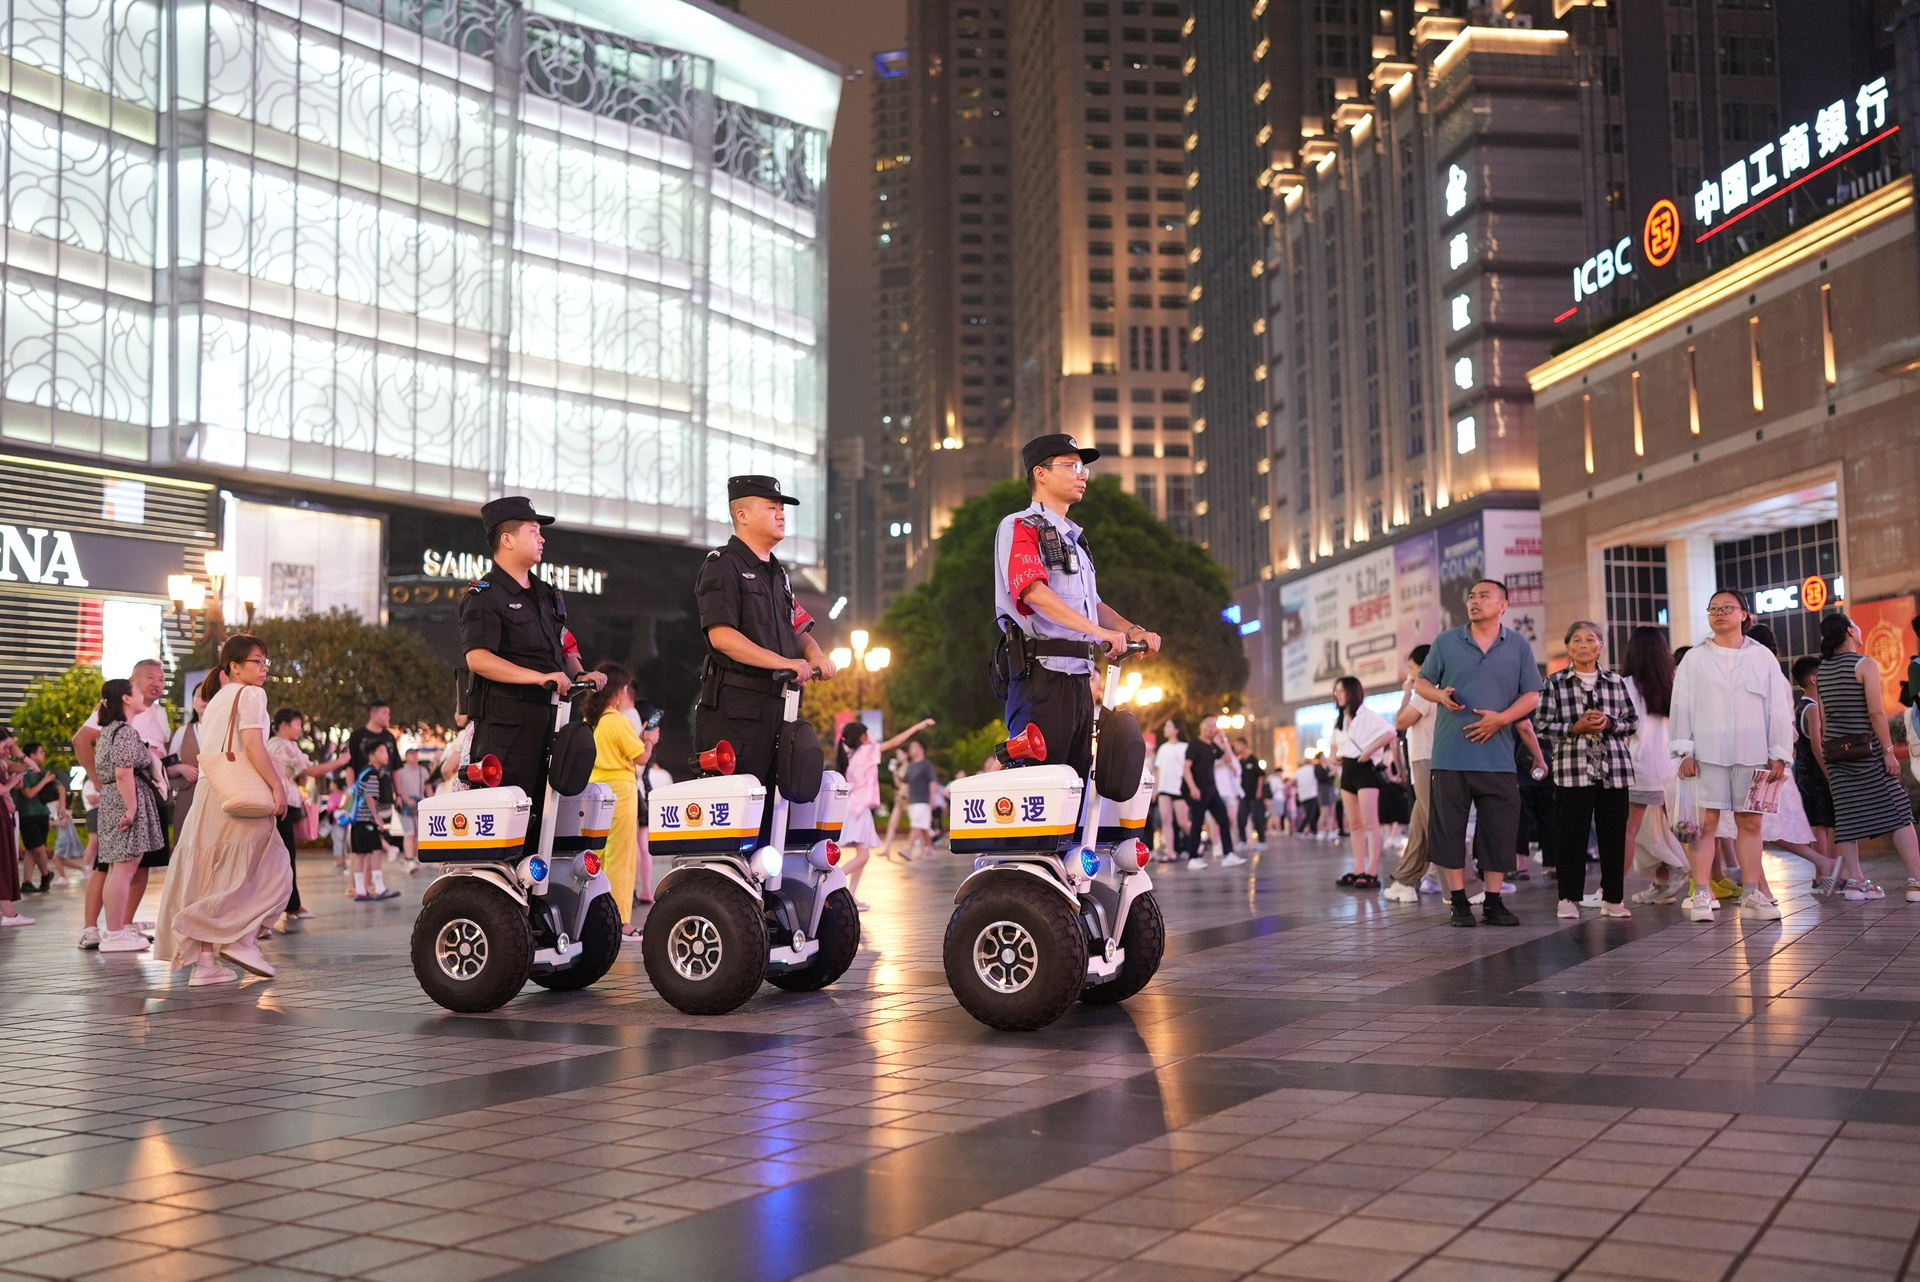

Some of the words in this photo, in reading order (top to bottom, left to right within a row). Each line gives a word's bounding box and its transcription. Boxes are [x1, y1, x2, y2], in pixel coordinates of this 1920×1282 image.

[1694, 76, 1889, 226] 中国工商银行
[1573, 235, 1633, 303] ICBC
[0, 524, 89, 588] NA
[1755, 585, 1798, 614] ICBC
[660, 803, 731, 828] 巡逻
[963, 796, 1047, 824] 巡逻
[428, 814, 495, 837] 巡逻
